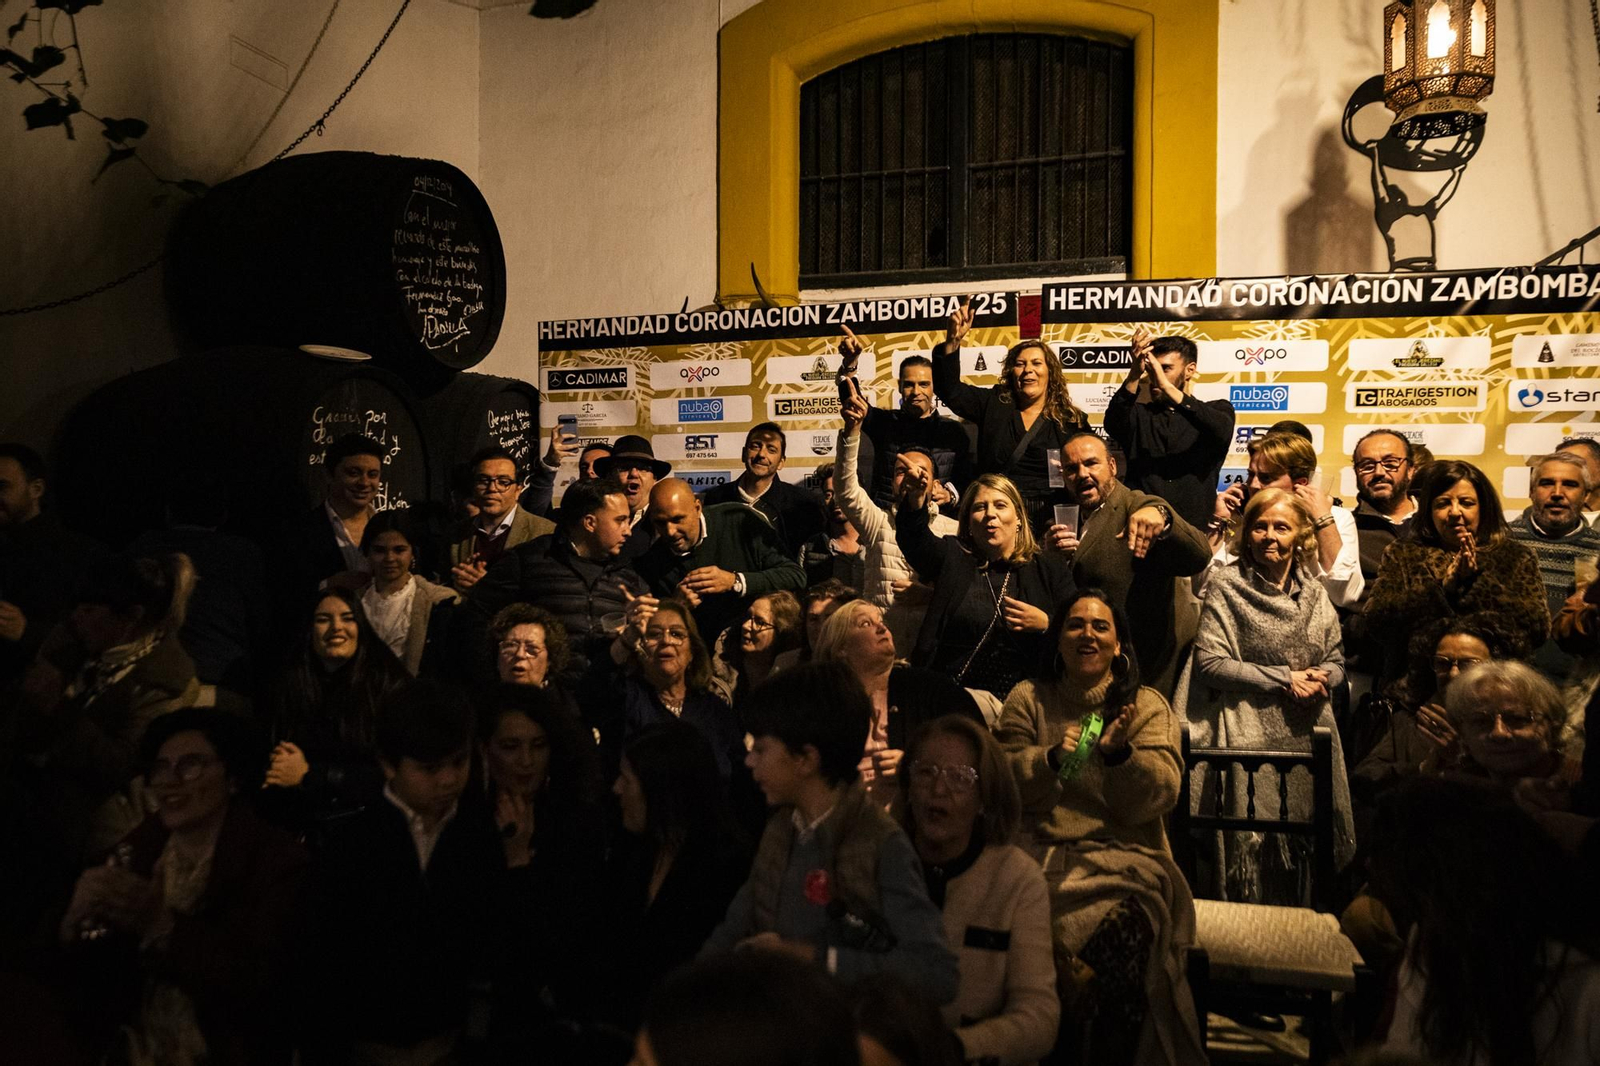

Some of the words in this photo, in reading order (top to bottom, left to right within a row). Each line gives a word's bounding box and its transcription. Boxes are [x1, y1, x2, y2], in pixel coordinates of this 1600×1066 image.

[1049, 285, 1222, 310] HERMANDAD
[1430, 272, 1600, 302] ZAMBOMBA
[539, 314, 670, 340] HERMANDAD
[826, 296, 960, 324] ZAMBOMBA
[565, 371, 627, 385] CADIMAR
[1379, 387, 1478, 398] TRAFIGESTION
[1378, 398, 1437, 406] ABOGADOS
[793, 406, 839, 415] ABOGADOS
[309, 450, 327, 465] est
[682, 476, 725, 486] AKITO
